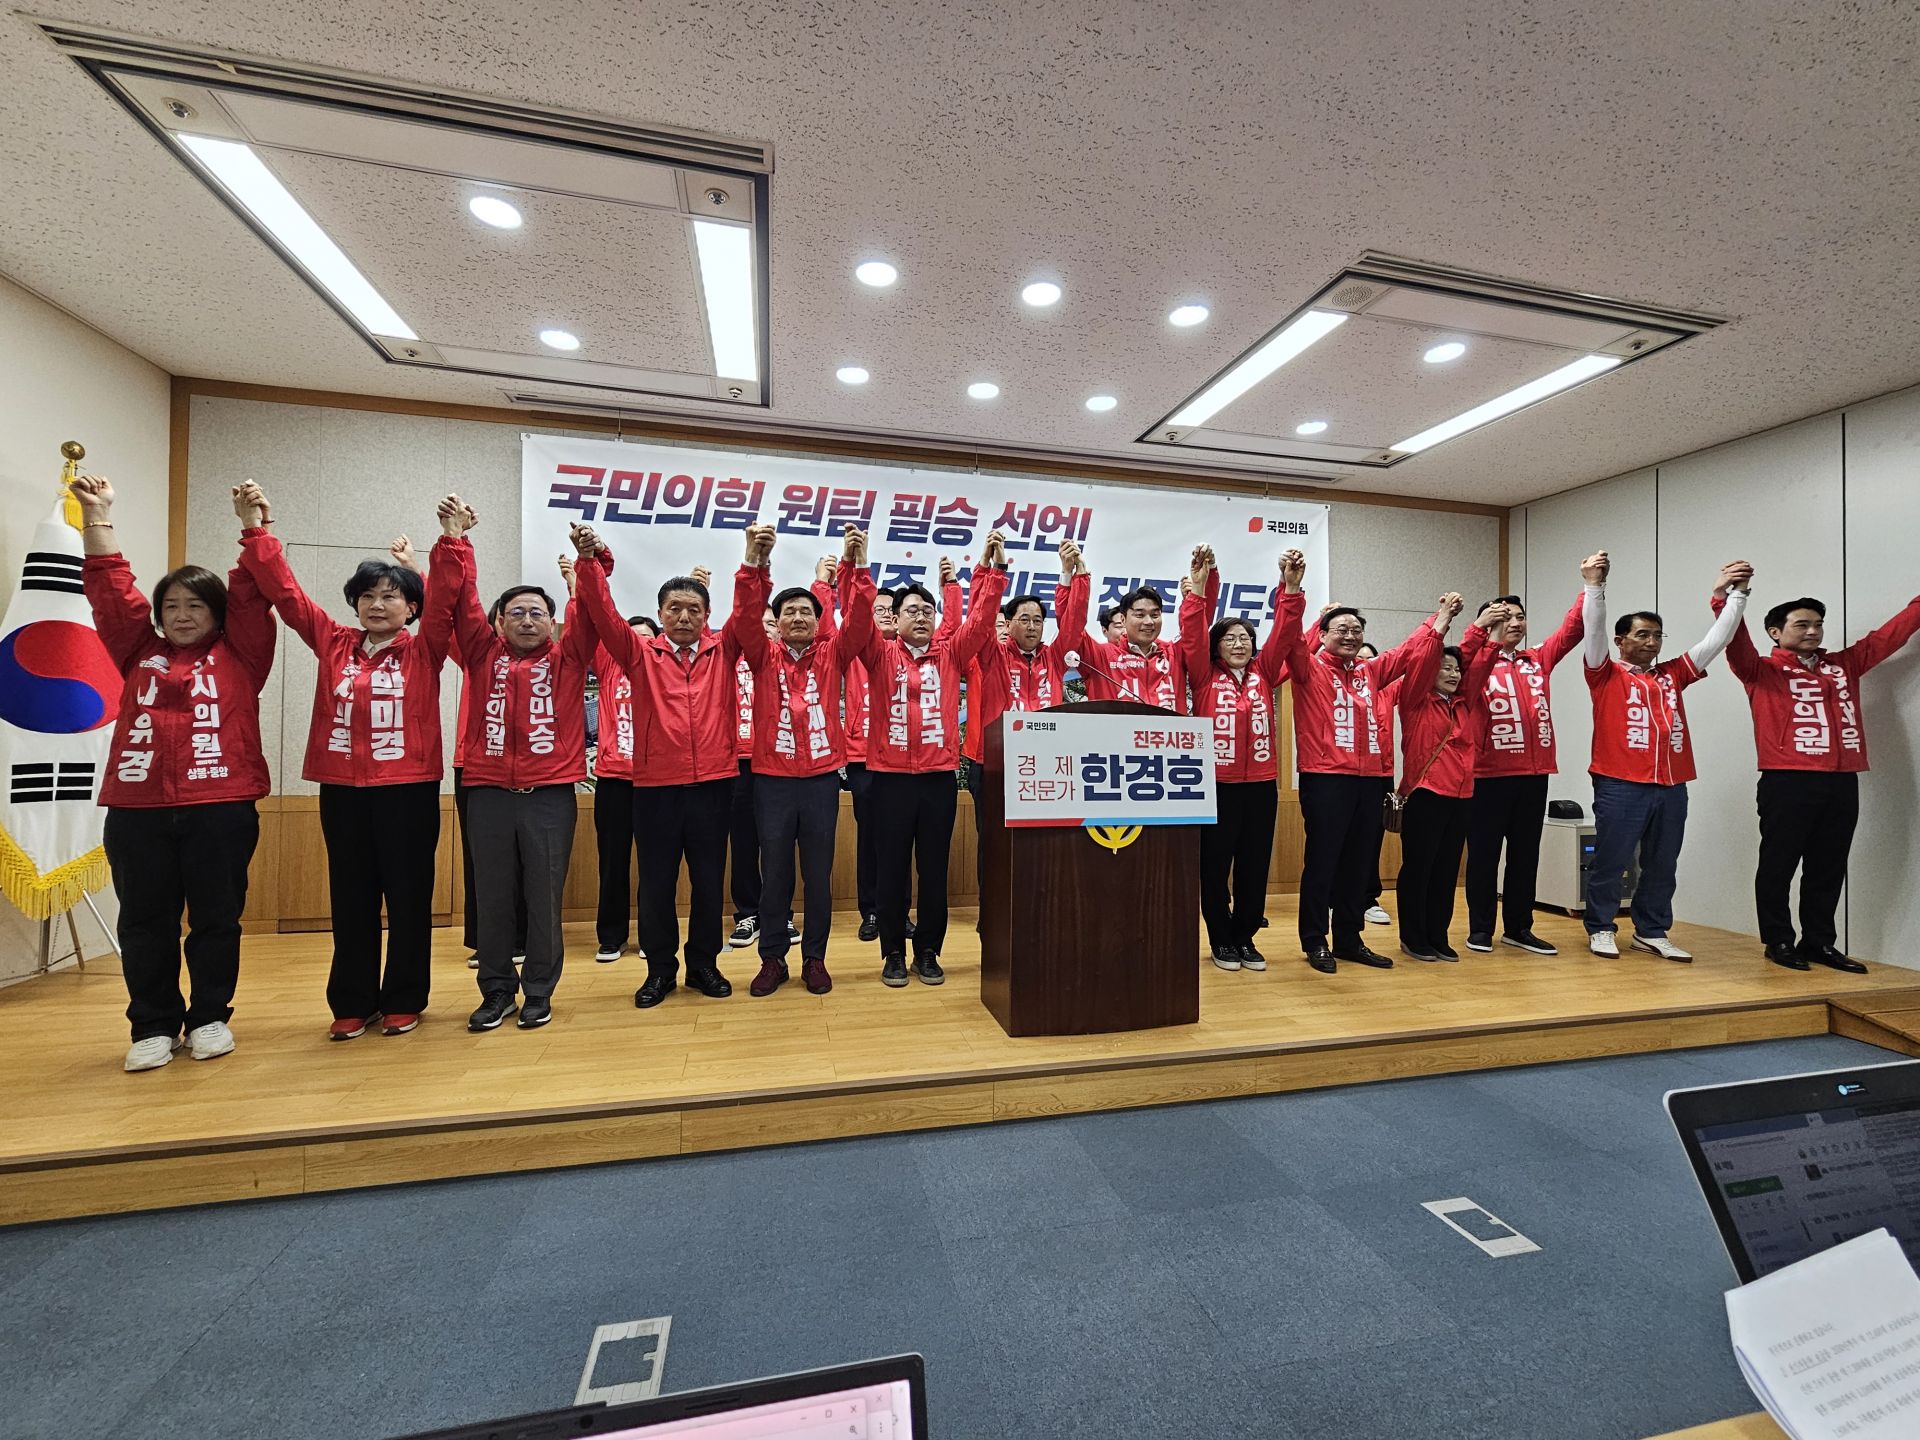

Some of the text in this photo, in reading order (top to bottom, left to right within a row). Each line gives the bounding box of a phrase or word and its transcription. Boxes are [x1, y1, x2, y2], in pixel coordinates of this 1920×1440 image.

[547, 464, 766, 531] 국민의힘
[777, 484, 877, 536] 원팀
[886, 493, 979, 547] 필승
[1266, 519, 1309, 535] 국민의힘
[191, 674, 222, 759] 시의원
[370, 669, 405, 761] 박미경
[528, 667, 555, 754] 강민승
[889, 682, 908, 746] 시의원
[1026, 721, 1057, 731] 국민의힘
[1133, 730, 1195, 749] 진주시장
[1214, 691, 1237, 764] 도의원
[1333, 688, 1354, 748] 시의원
[1486, 673, 1525, 750] 시의원
[1626, 686, 1649, 749] 시의원
[1789, 678, 1830, 753] 도의원
[1018, 780, 1076, 801] 전문가
[1081, 753, 1205, 801] 한경호
